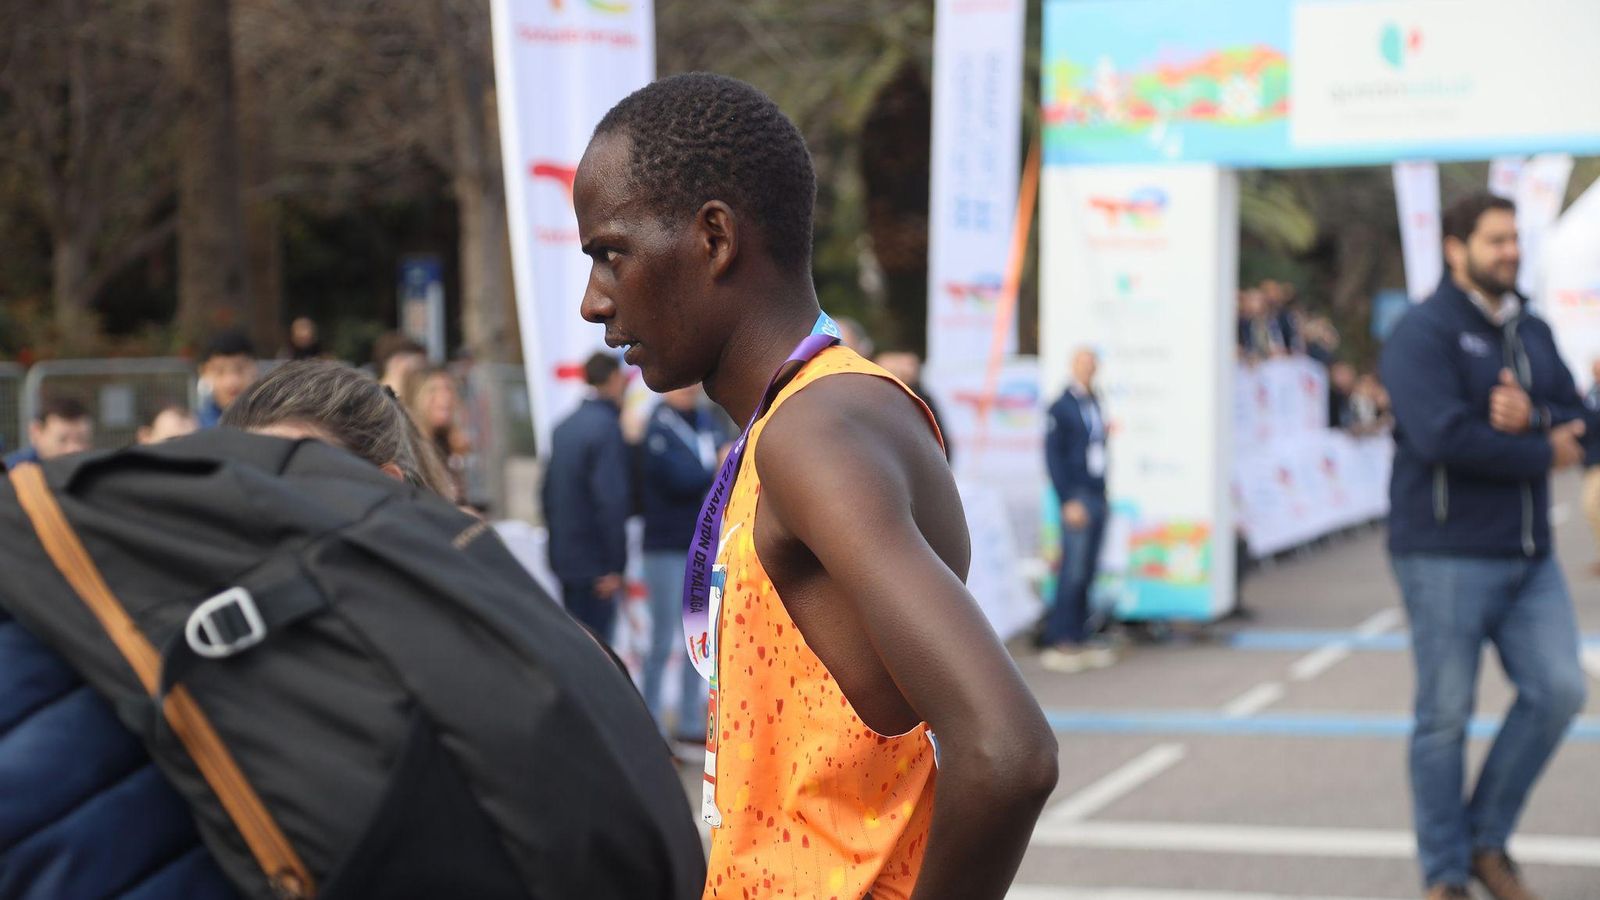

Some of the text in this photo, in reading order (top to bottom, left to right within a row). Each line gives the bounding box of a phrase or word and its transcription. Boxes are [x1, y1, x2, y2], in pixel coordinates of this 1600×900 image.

[689, 458, 734, 614] 1/2 MARATÓN DE MÁLAGA
